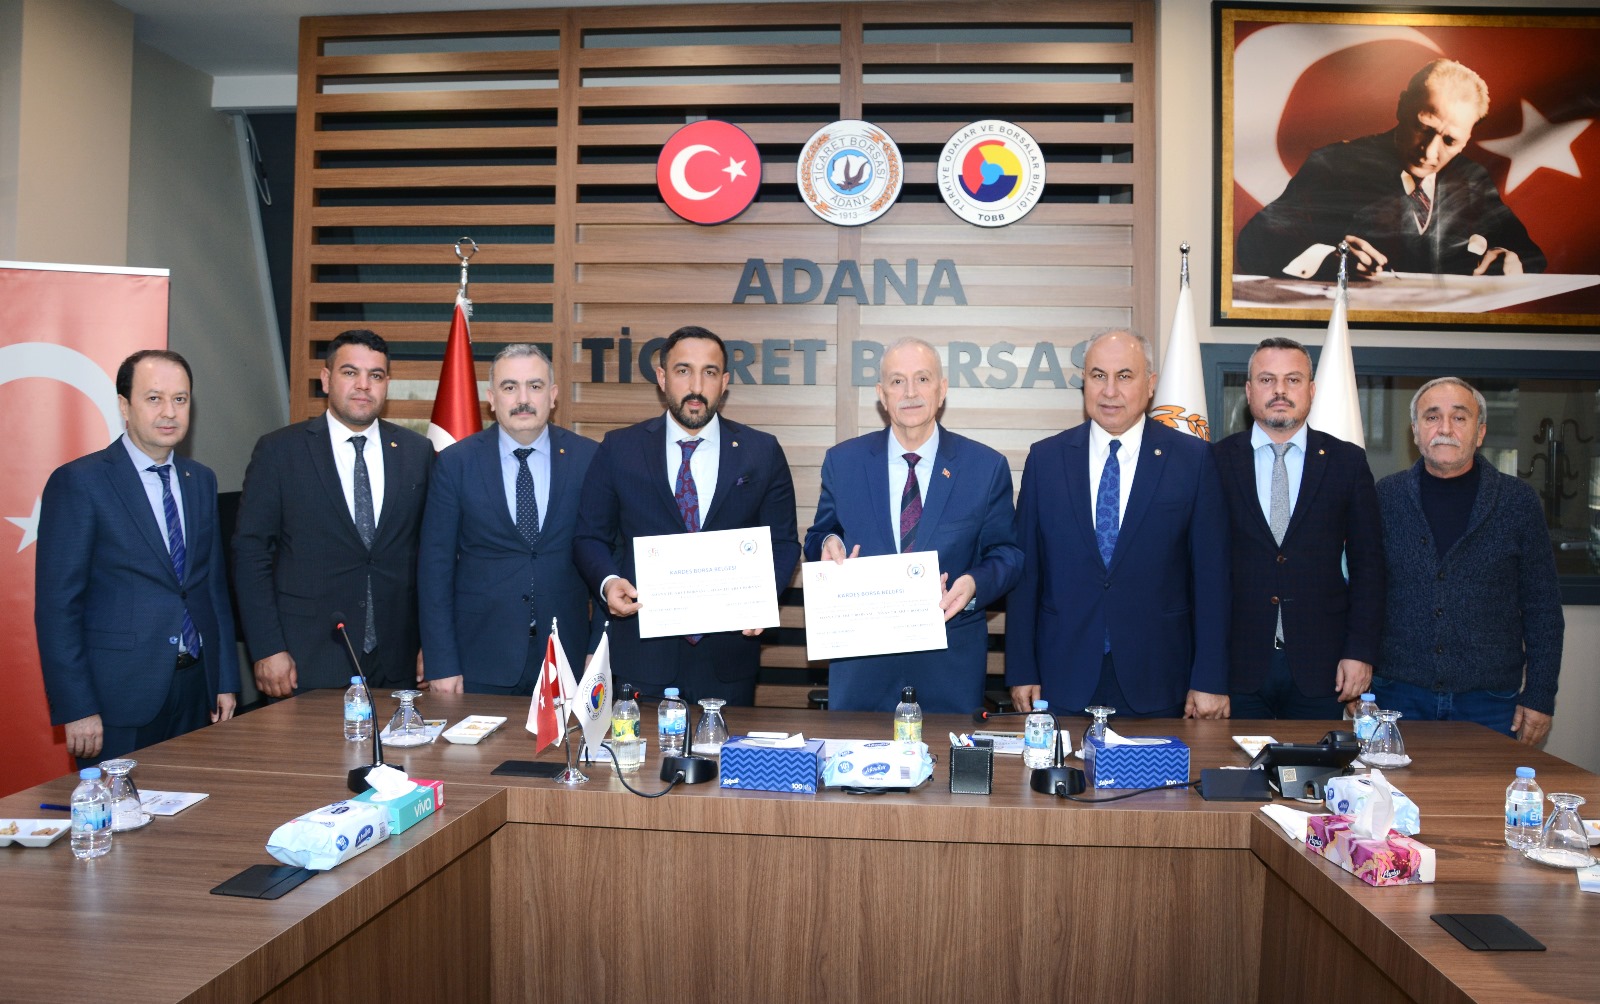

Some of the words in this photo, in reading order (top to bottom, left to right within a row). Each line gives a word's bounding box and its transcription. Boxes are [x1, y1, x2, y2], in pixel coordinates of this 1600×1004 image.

[945, 128, 976, 162] ODALAR
[981, 124, 994, 132] VE
[850, 137, 886, 180] BORSASI
[1000, 125, 1040, 169] BORSALAR
[830, 195, 870, 208] ADANA
[942, 166, 966, 211] TÜRKİYE
[839, 211, 858, 220] 1913
[978, 213, 1005, 222] TOBB
[733, 258, 967, 305] ADANA
[582, 326, 827, 385] TİCRET
[791, 782, 803, 790] 100
